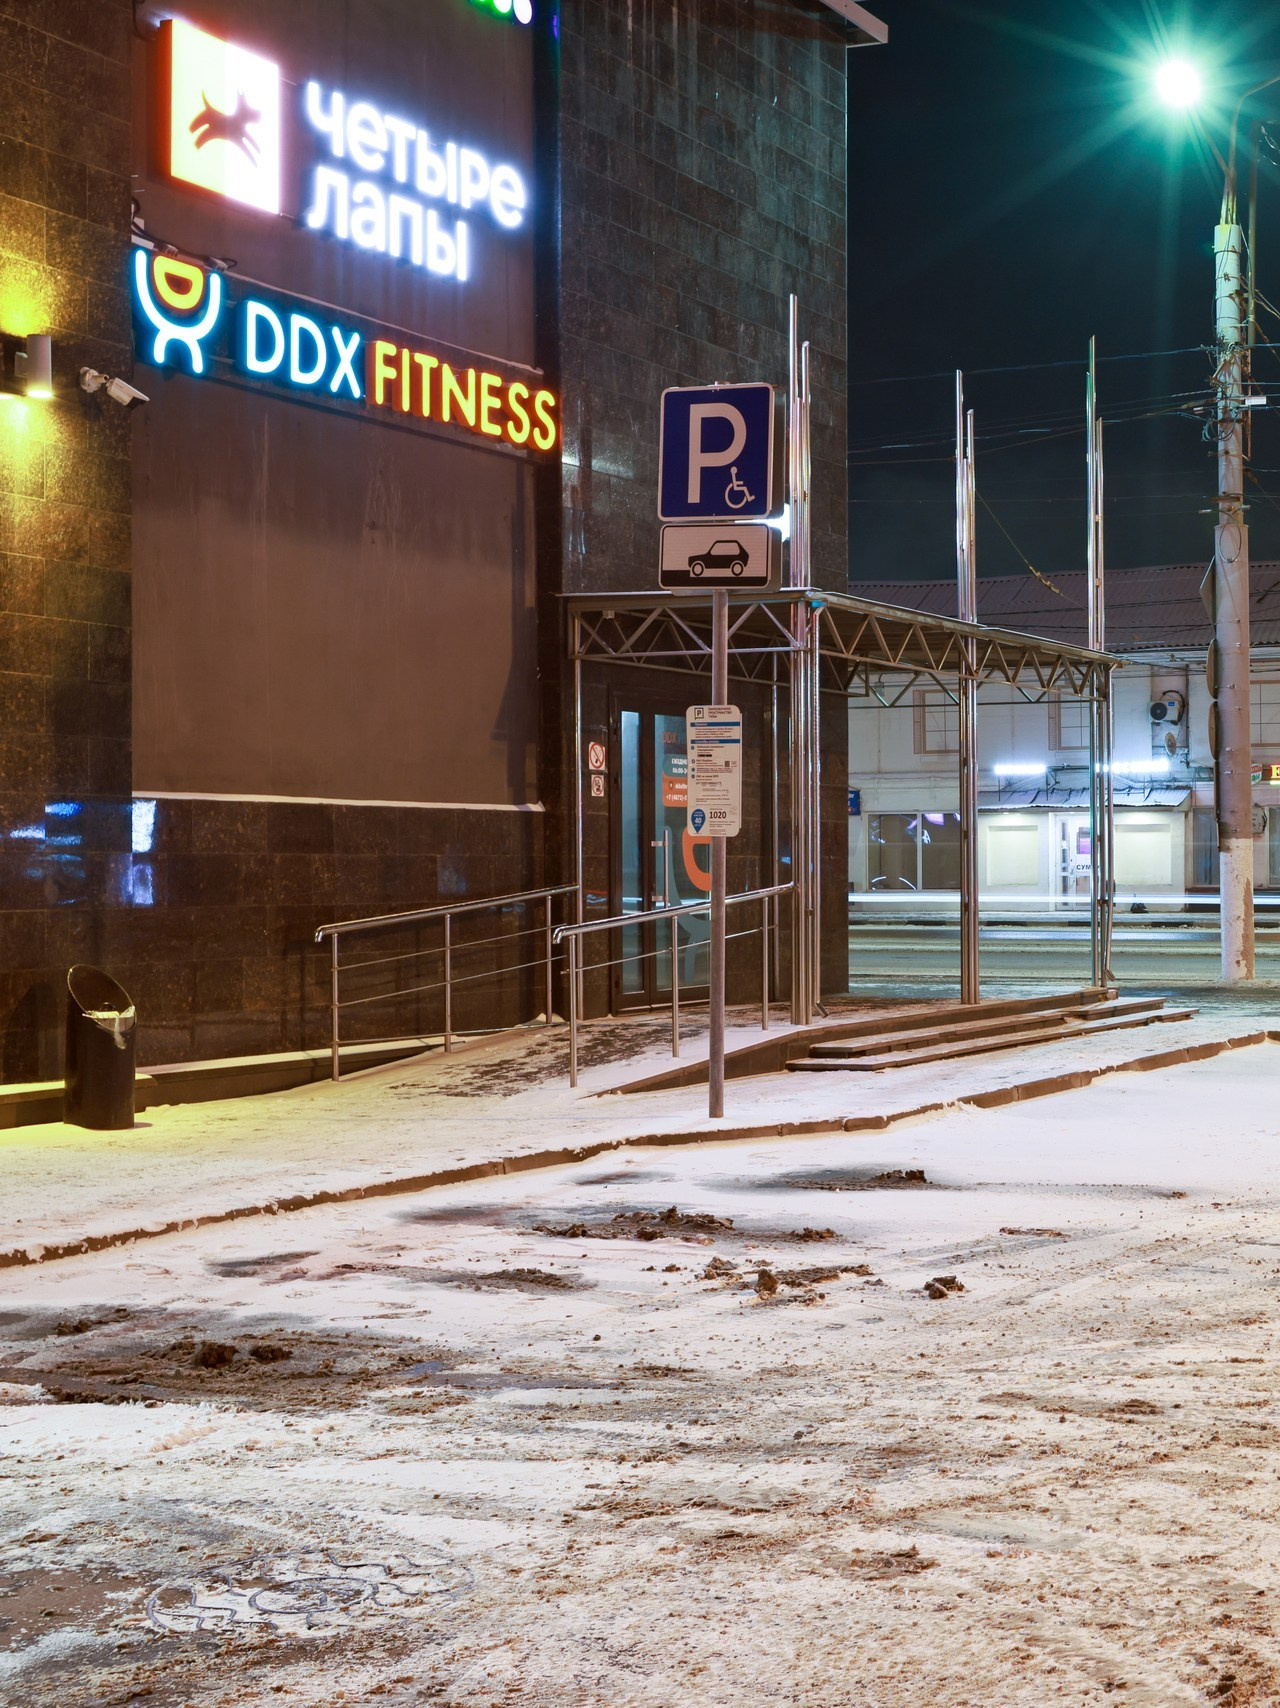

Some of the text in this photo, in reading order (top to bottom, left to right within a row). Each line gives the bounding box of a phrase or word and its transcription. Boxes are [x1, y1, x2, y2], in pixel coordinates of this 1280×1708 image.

[306, 165, 470, 281] лапы
[245, 300, 558, 452] DDX FITNESS
[687, 402, 747, 504] P
[709, 811, 727, 819] 1020
